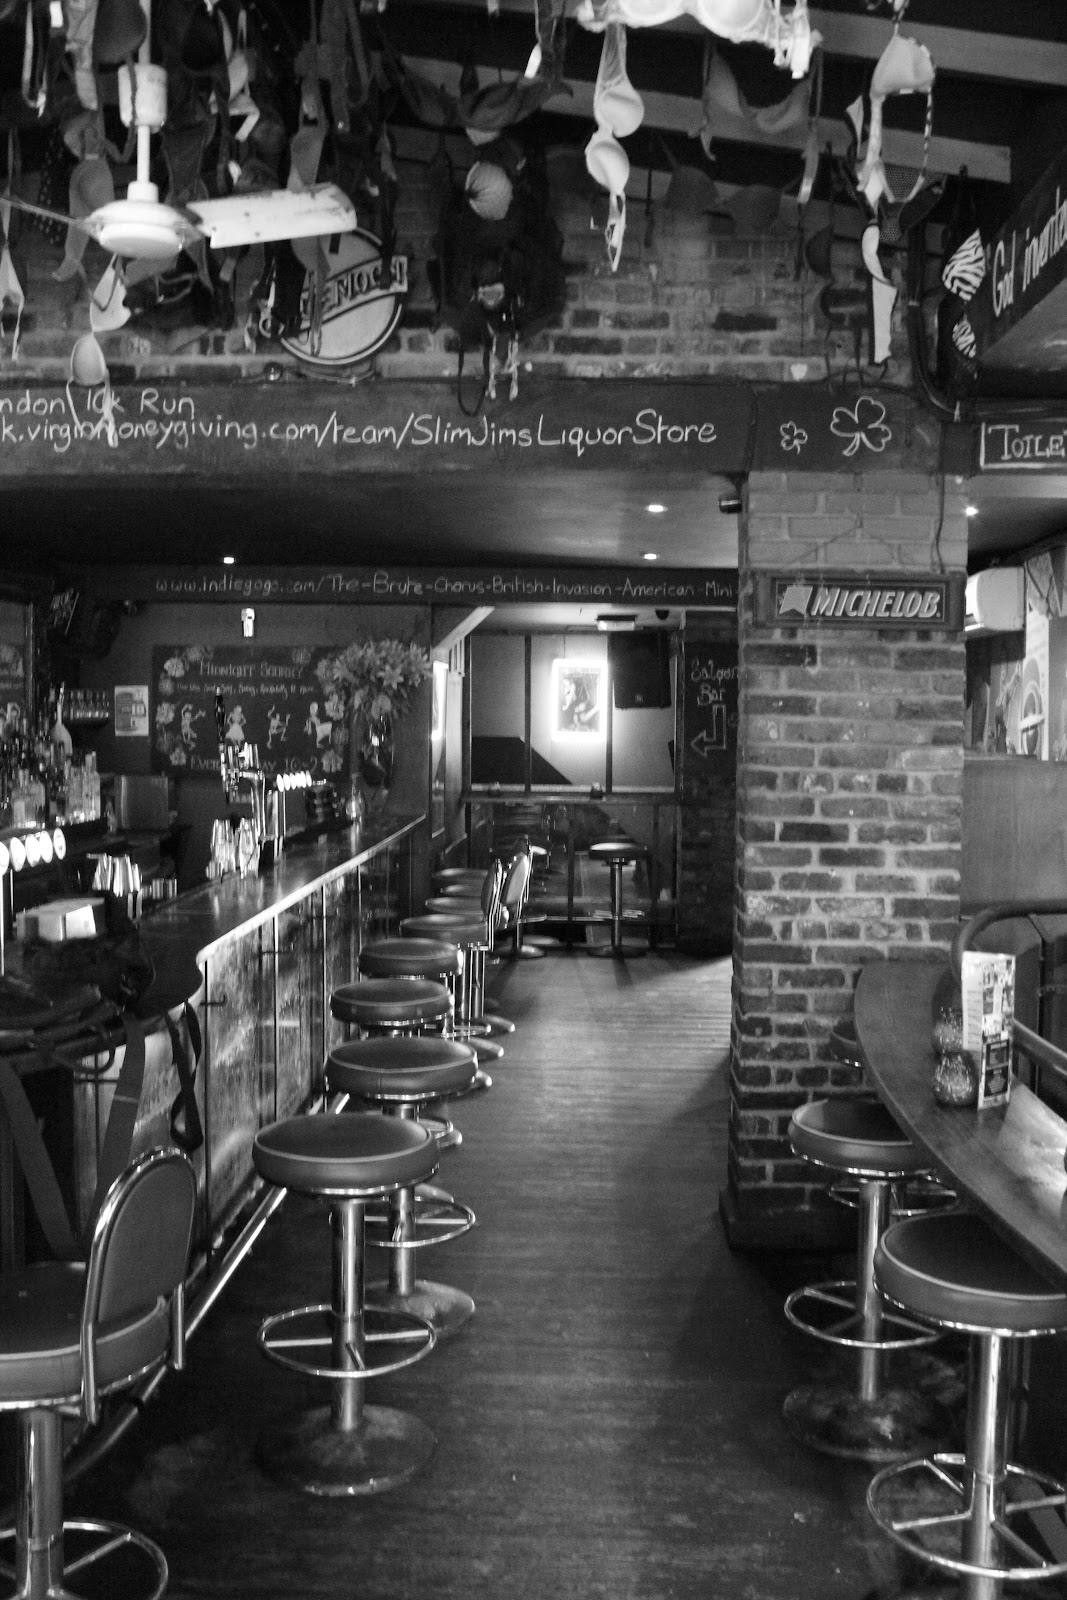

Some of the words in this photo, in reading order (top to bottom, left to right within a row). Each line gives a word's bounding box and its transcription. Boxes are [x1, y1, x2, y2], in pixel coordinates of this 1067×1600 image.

[992, 230, 1016, 318] God
[140, 387, 195, 419] Run
[811, 587, 941, 619] MICHELOB
[697, 683, 726, 707] Bar
